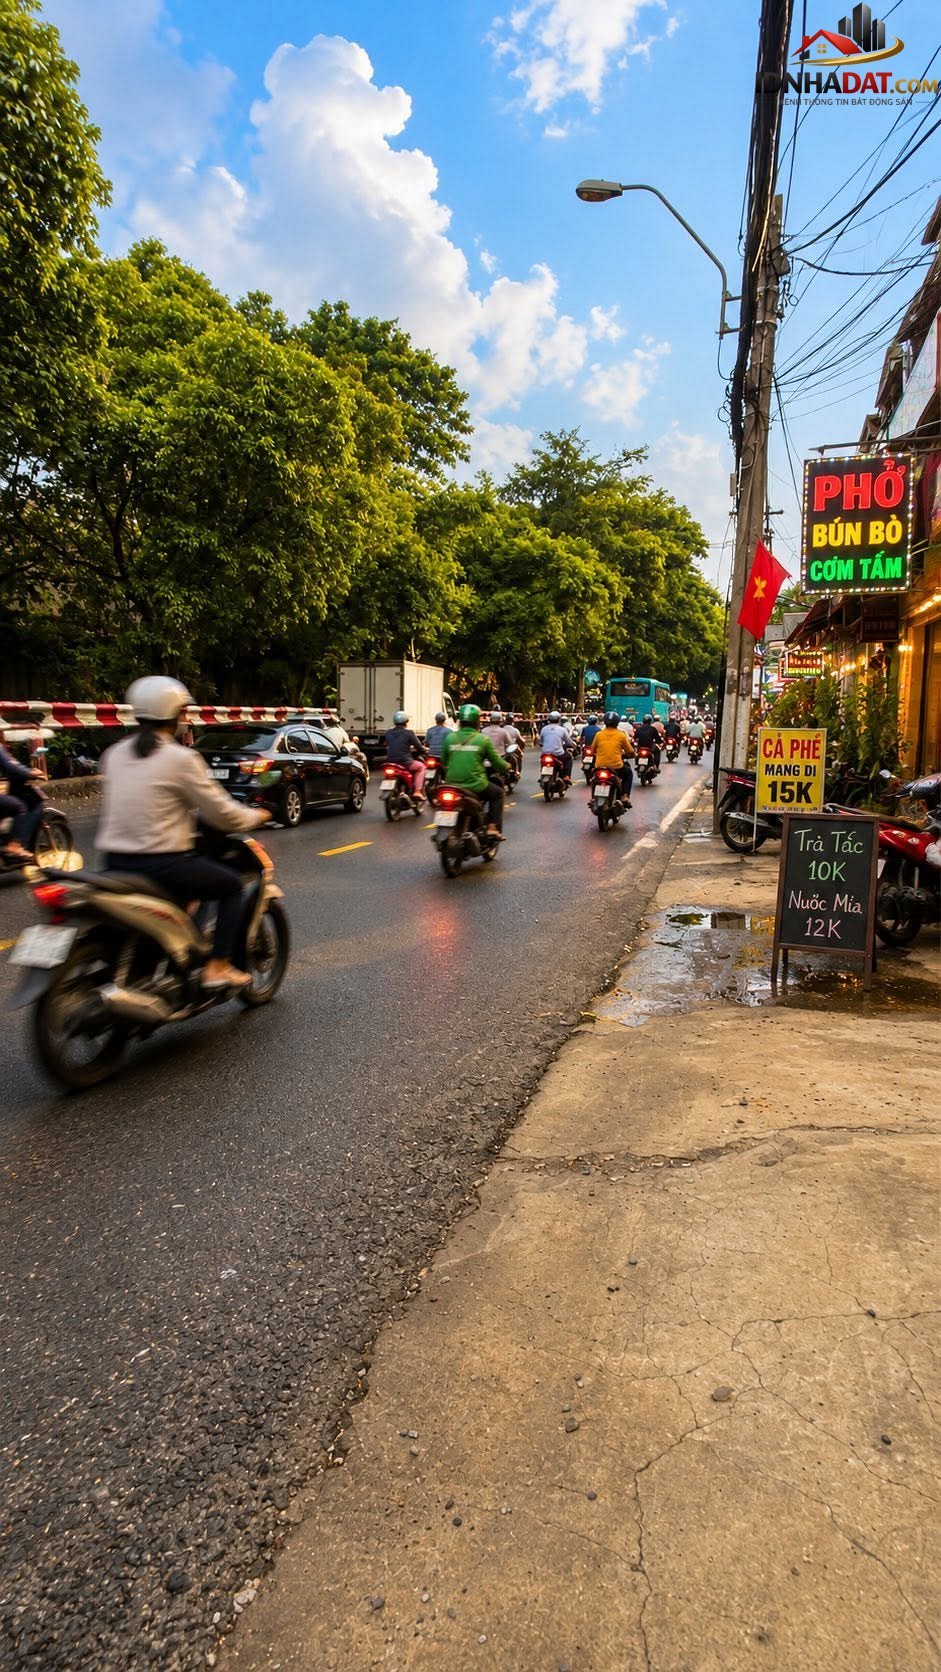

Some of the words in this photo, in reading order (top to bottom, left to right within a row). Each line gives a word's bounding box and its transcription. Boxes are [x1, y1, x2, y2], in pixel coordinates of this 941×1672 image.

[813, 458, 907, 512] PHỞ
[812, 516, 862, 548] BÚN
[868, 514, 903, 545] BÒ
[810, 555, 854, 582] CƠM
[859, 550, 903, 580] TẤM
[765, 764, 800, 777] MANG
[768, 781, 813, 804] 15K
[808, 860, 846, 882] 10K
[805, 917, 842, 939] 12K
